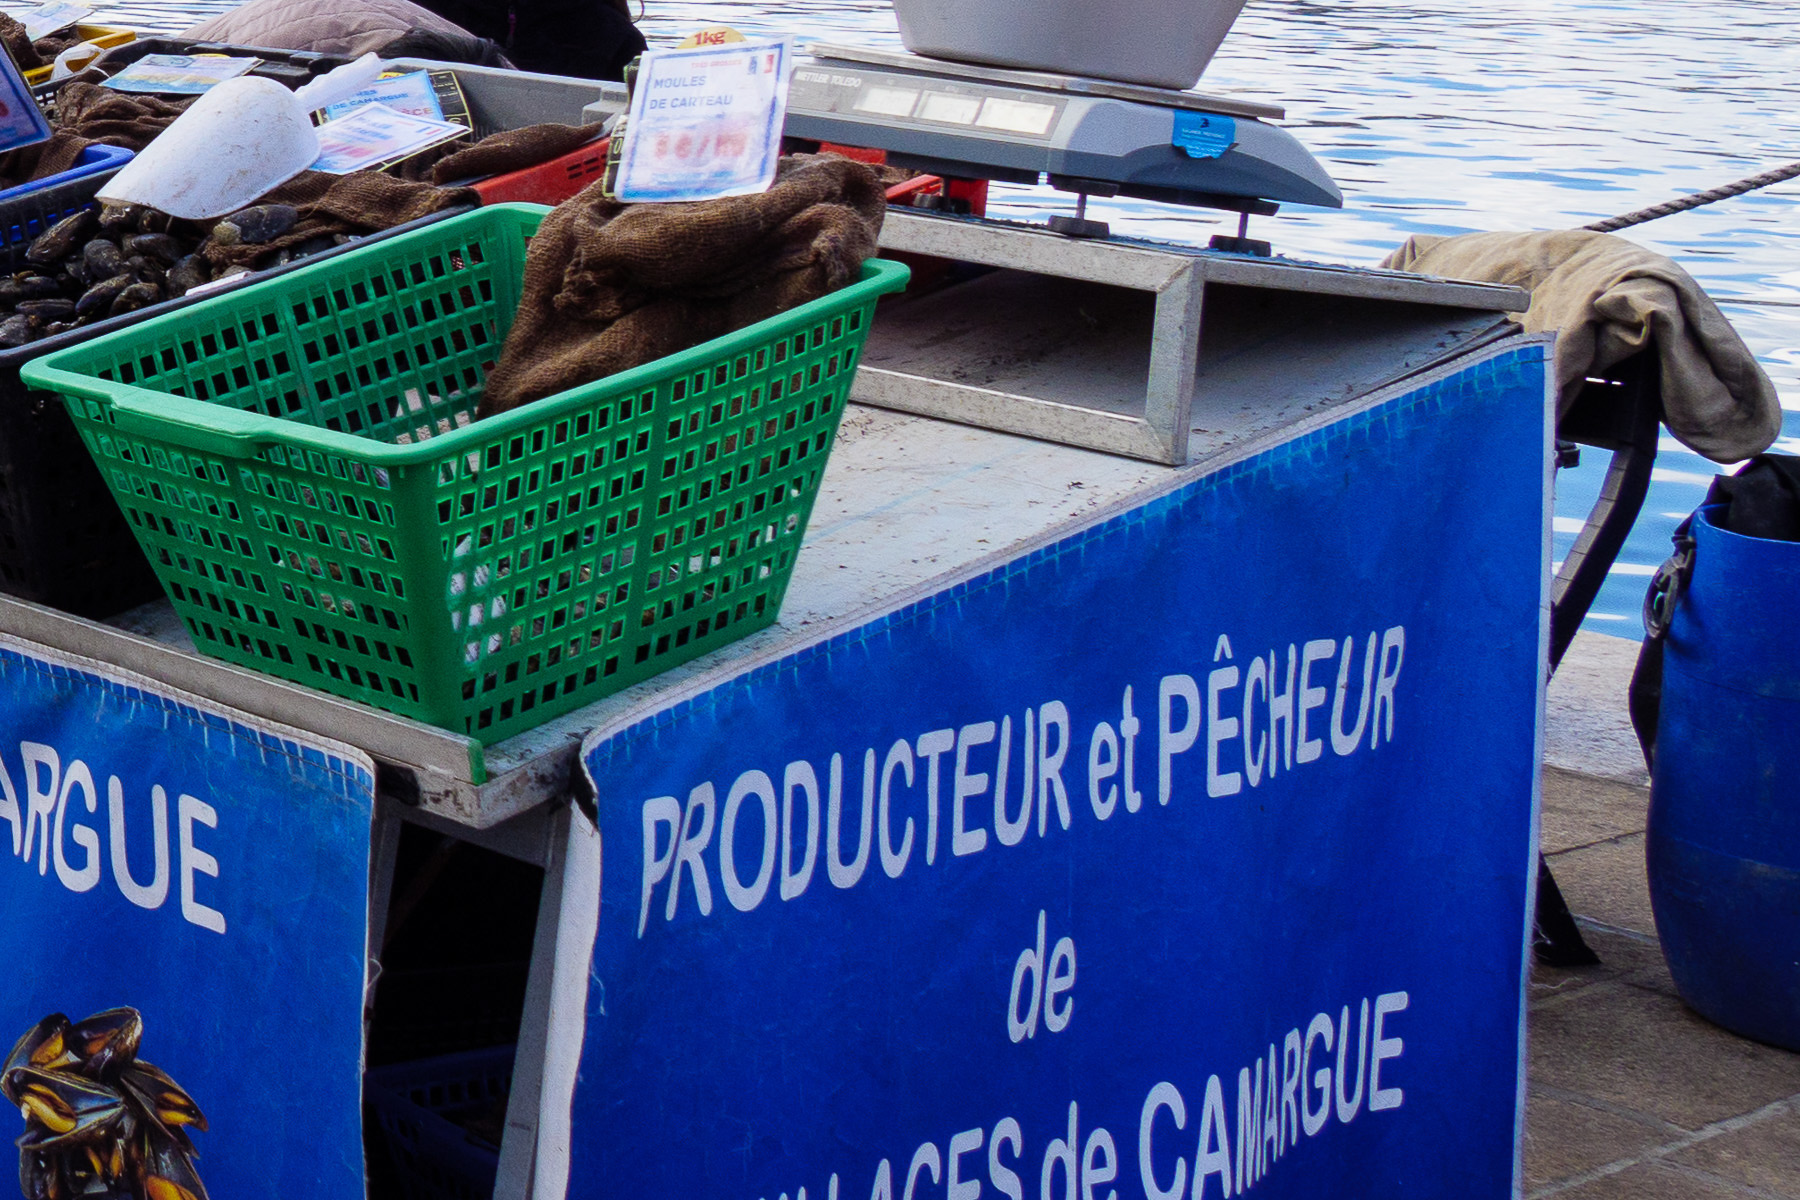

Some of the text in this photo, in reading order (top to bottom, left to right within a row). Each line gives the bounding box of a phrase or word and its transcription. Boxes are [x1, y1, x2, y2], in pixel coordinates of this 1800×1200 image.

[694, 31, 727, 45] 1kg
[653, 76, 707, 89] MOULES
[831, 75, 862, 88] TOLEDO
[649, 95, 734, 110] DE CARTEAU
[638, 626, 1406, 940] PRODUCTEUR et PÊCHEUR
[1007, 909, 1078, 1044] de
[1041, 1100, 1117, 1200] de
[1138, 990, 1409, 1200] CAMARGUE
